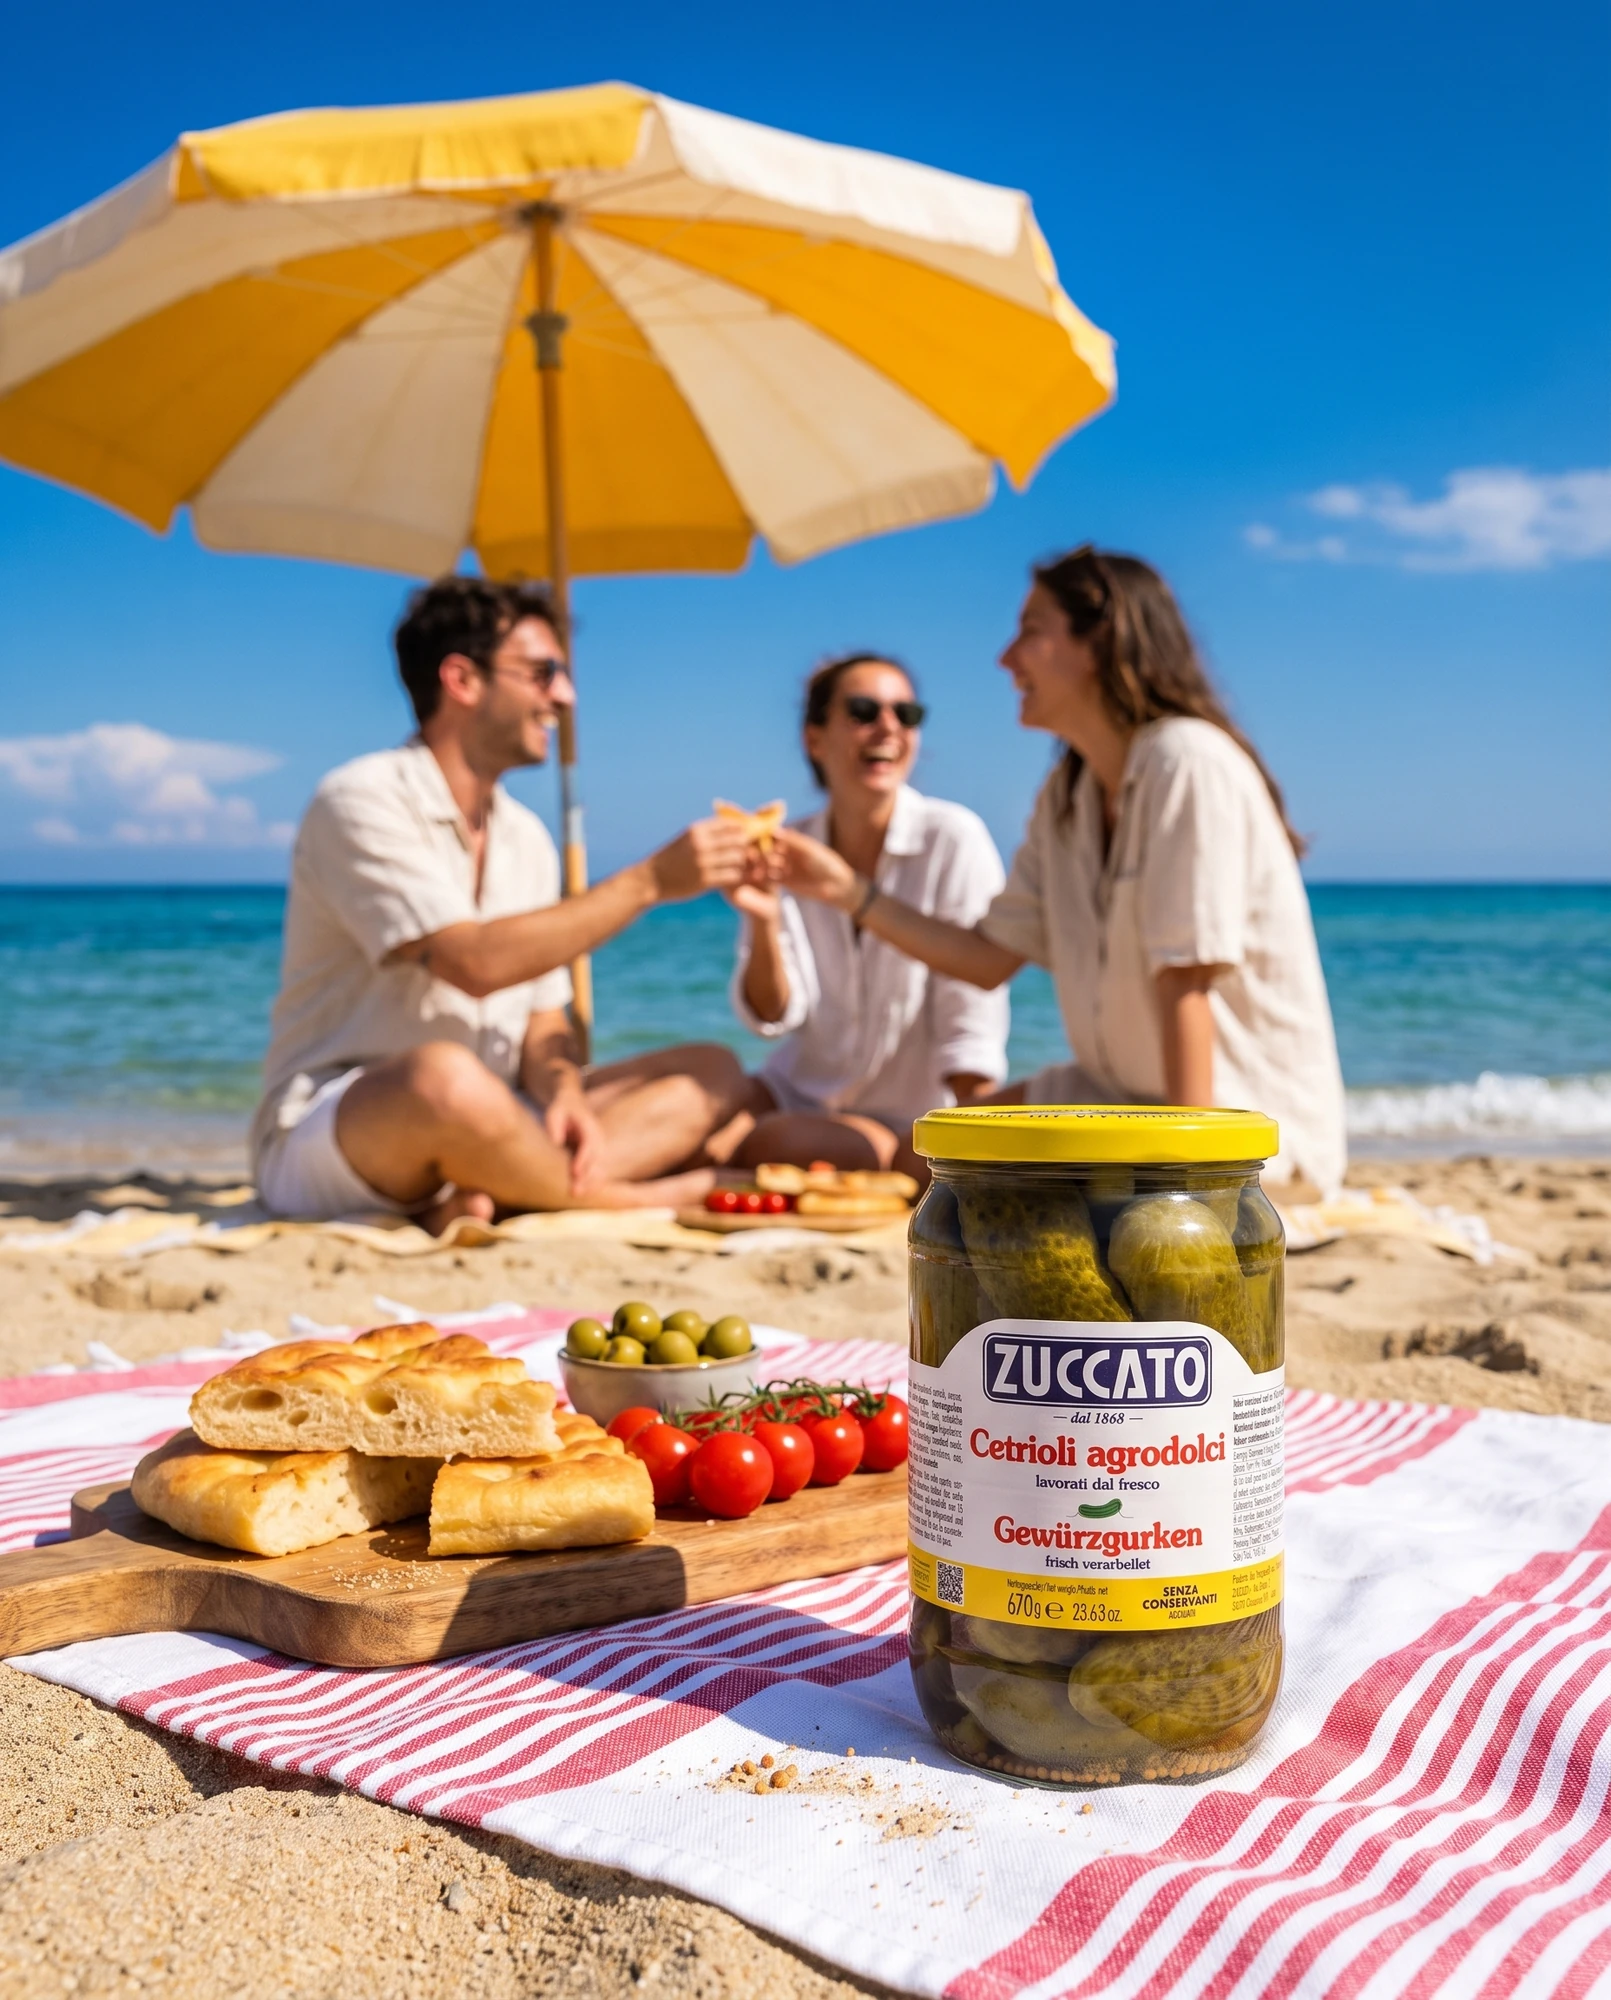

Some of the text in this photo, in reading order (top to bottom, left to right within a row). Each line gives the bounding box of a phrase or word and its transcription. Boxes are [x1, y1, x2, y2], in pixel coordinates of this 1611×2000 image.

[992, 1343, 1206, 1400] ZUCCATO
[1070, 1412, 1125, 1425] dal 1868
[969, 1428, 1077, 1466] Cetrioli
[1086, 1433, 1226, 1474] agrodolci
[1035, 1474, 1160, 1491] lavorati dal fresco
[993, 1515, 1203, 1558] Gewürzgurken
[1045, 1555, 1079, 1569] frisch
[1163, 1585, 1199, 1597] SENZA
[1007, 1592, 1041, 1620] 670g
[1072, 1602, 1106, 1622] 23.63
[1107, 1609, 1123, 1622] oz.
[1142, 1593, 1217, 1610] CONSERVANTI
